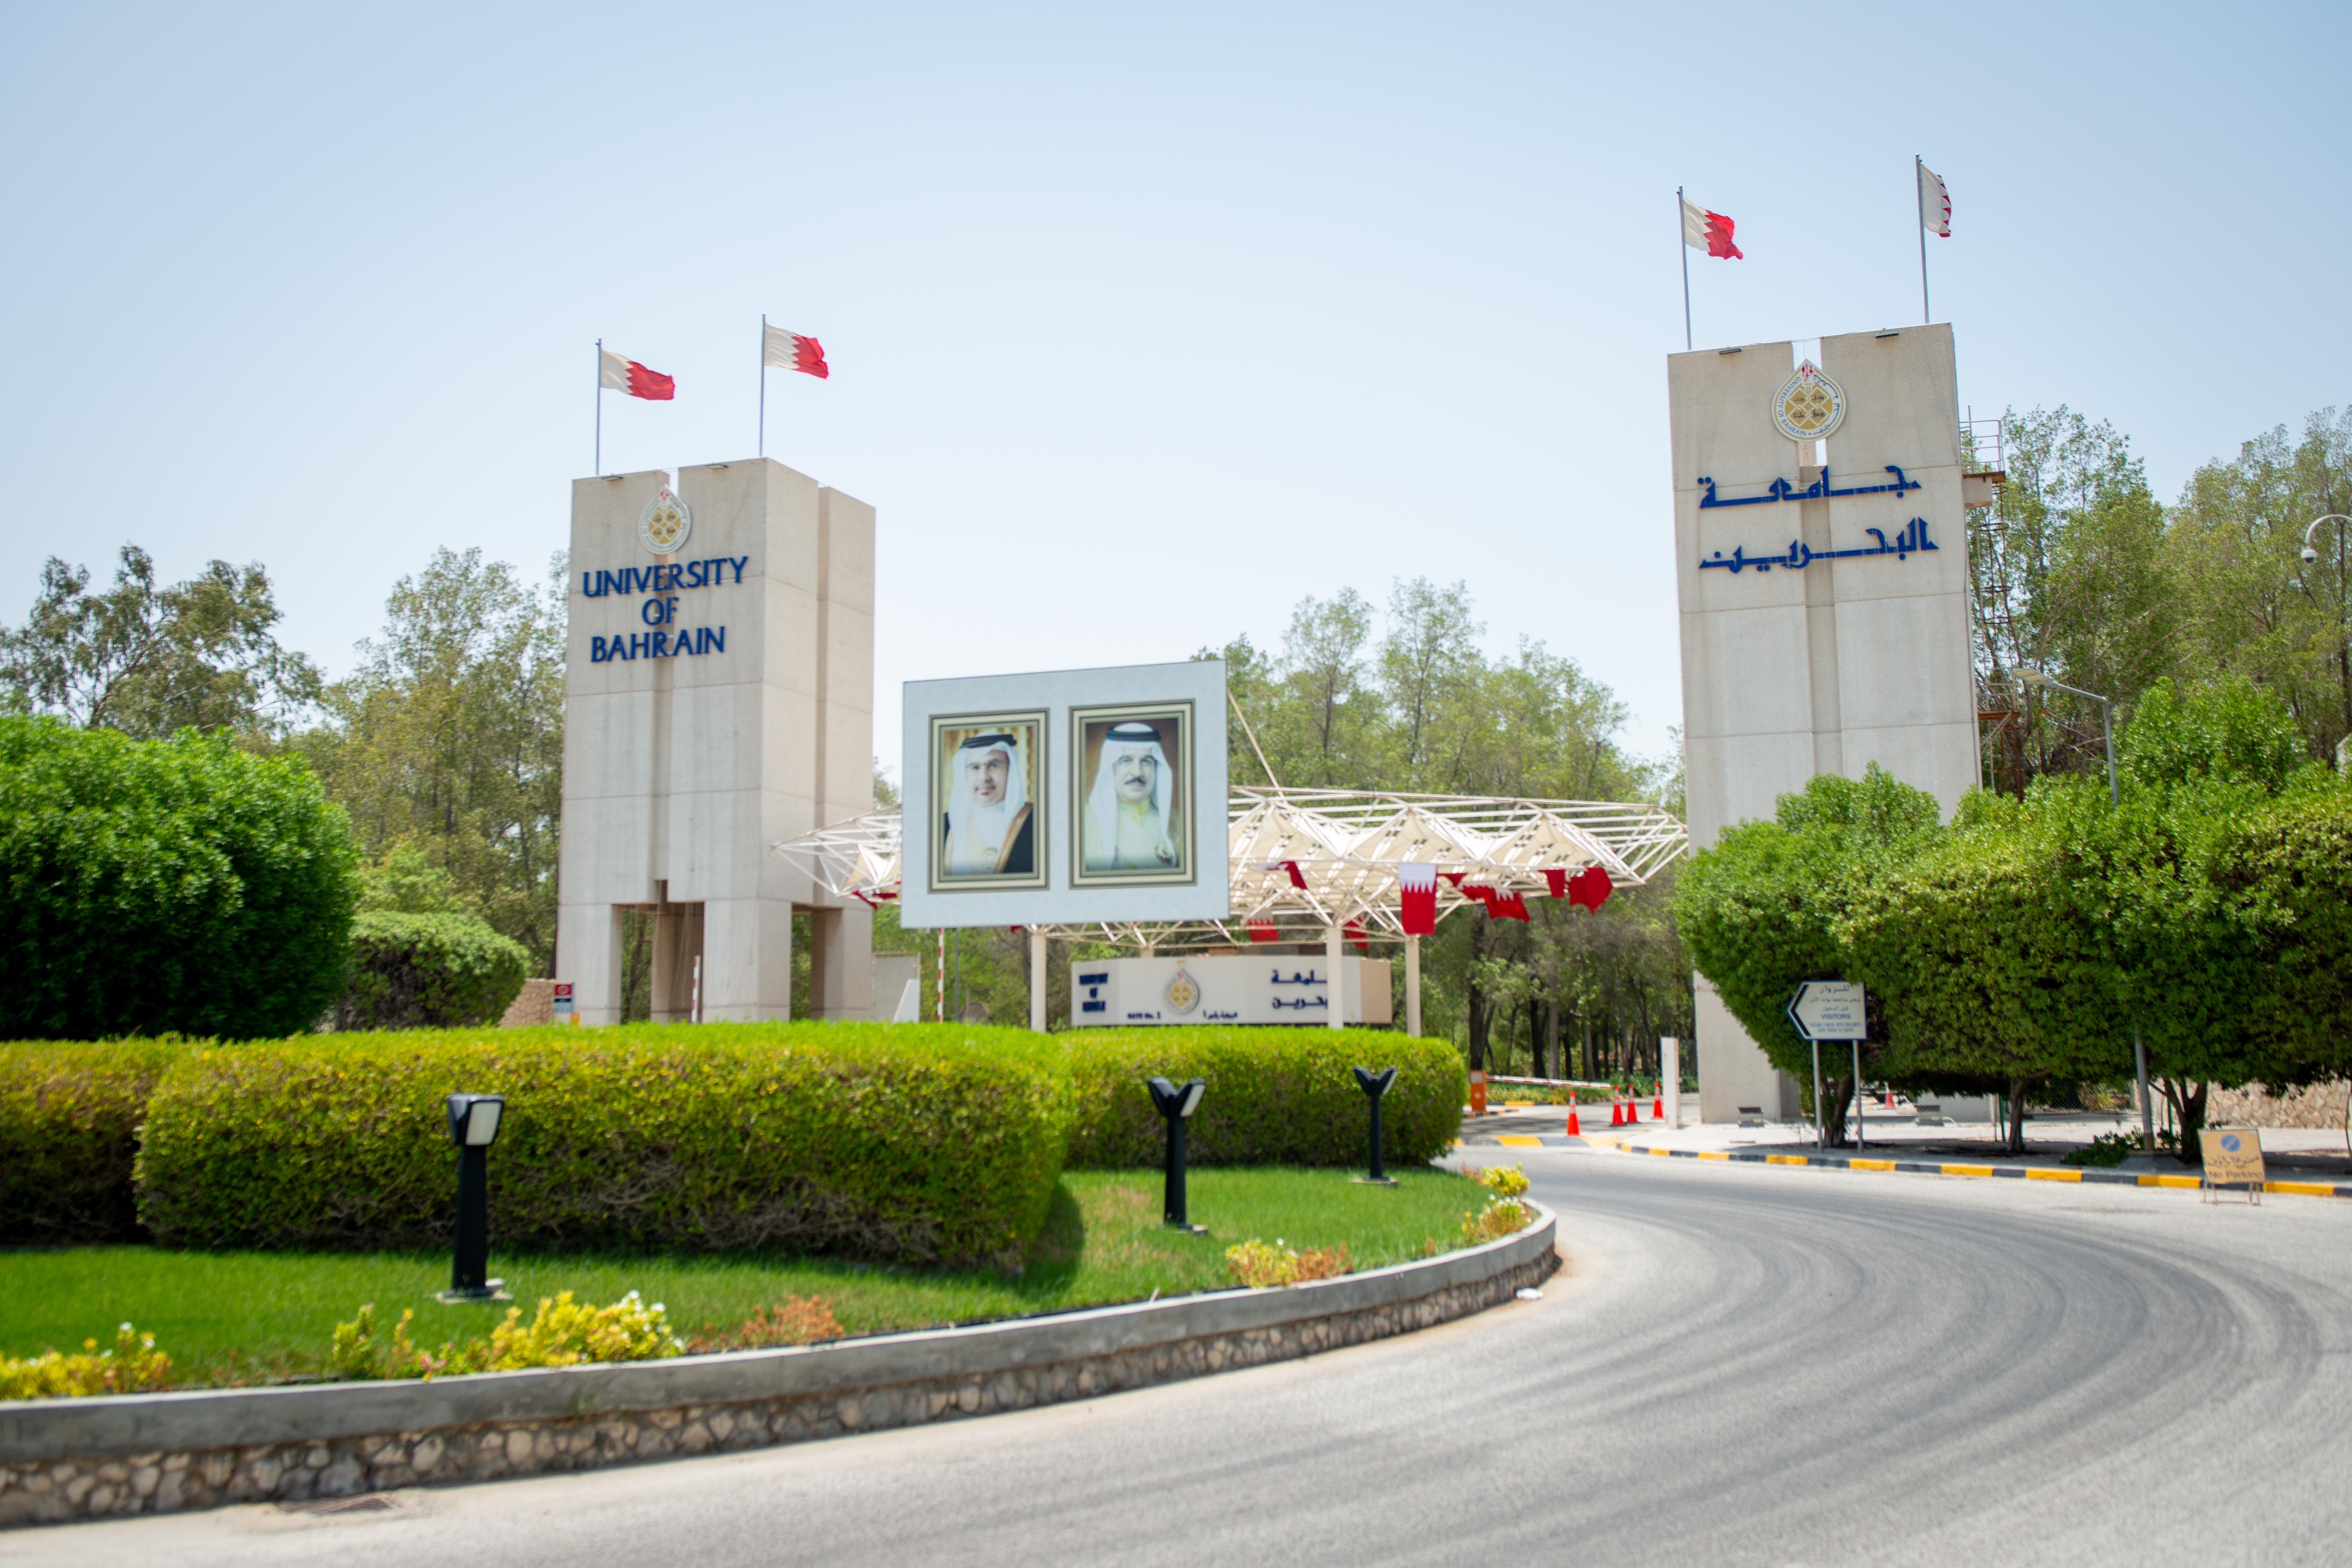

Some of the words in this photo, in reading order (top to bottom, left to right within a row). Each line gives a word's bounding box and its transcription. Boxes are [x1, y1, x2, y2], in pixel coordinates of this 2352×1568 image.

[1778, 377, 1802, 408] UNIVERSITY
[1781, 419, 1807, 436] BAHRAIN
[1697, 465, 1922, 509] جامعة
[1699, 516, 1939, 574] البحرين
[582, 556, 749, 598] UNIVERSITY
[641, 597, 679, 626] OF
[590, 626, 725, 663] BAHRAIN
[1271, 969, 1327, 986] امعة
[2226, 1171, 2262, 1180] Parking
